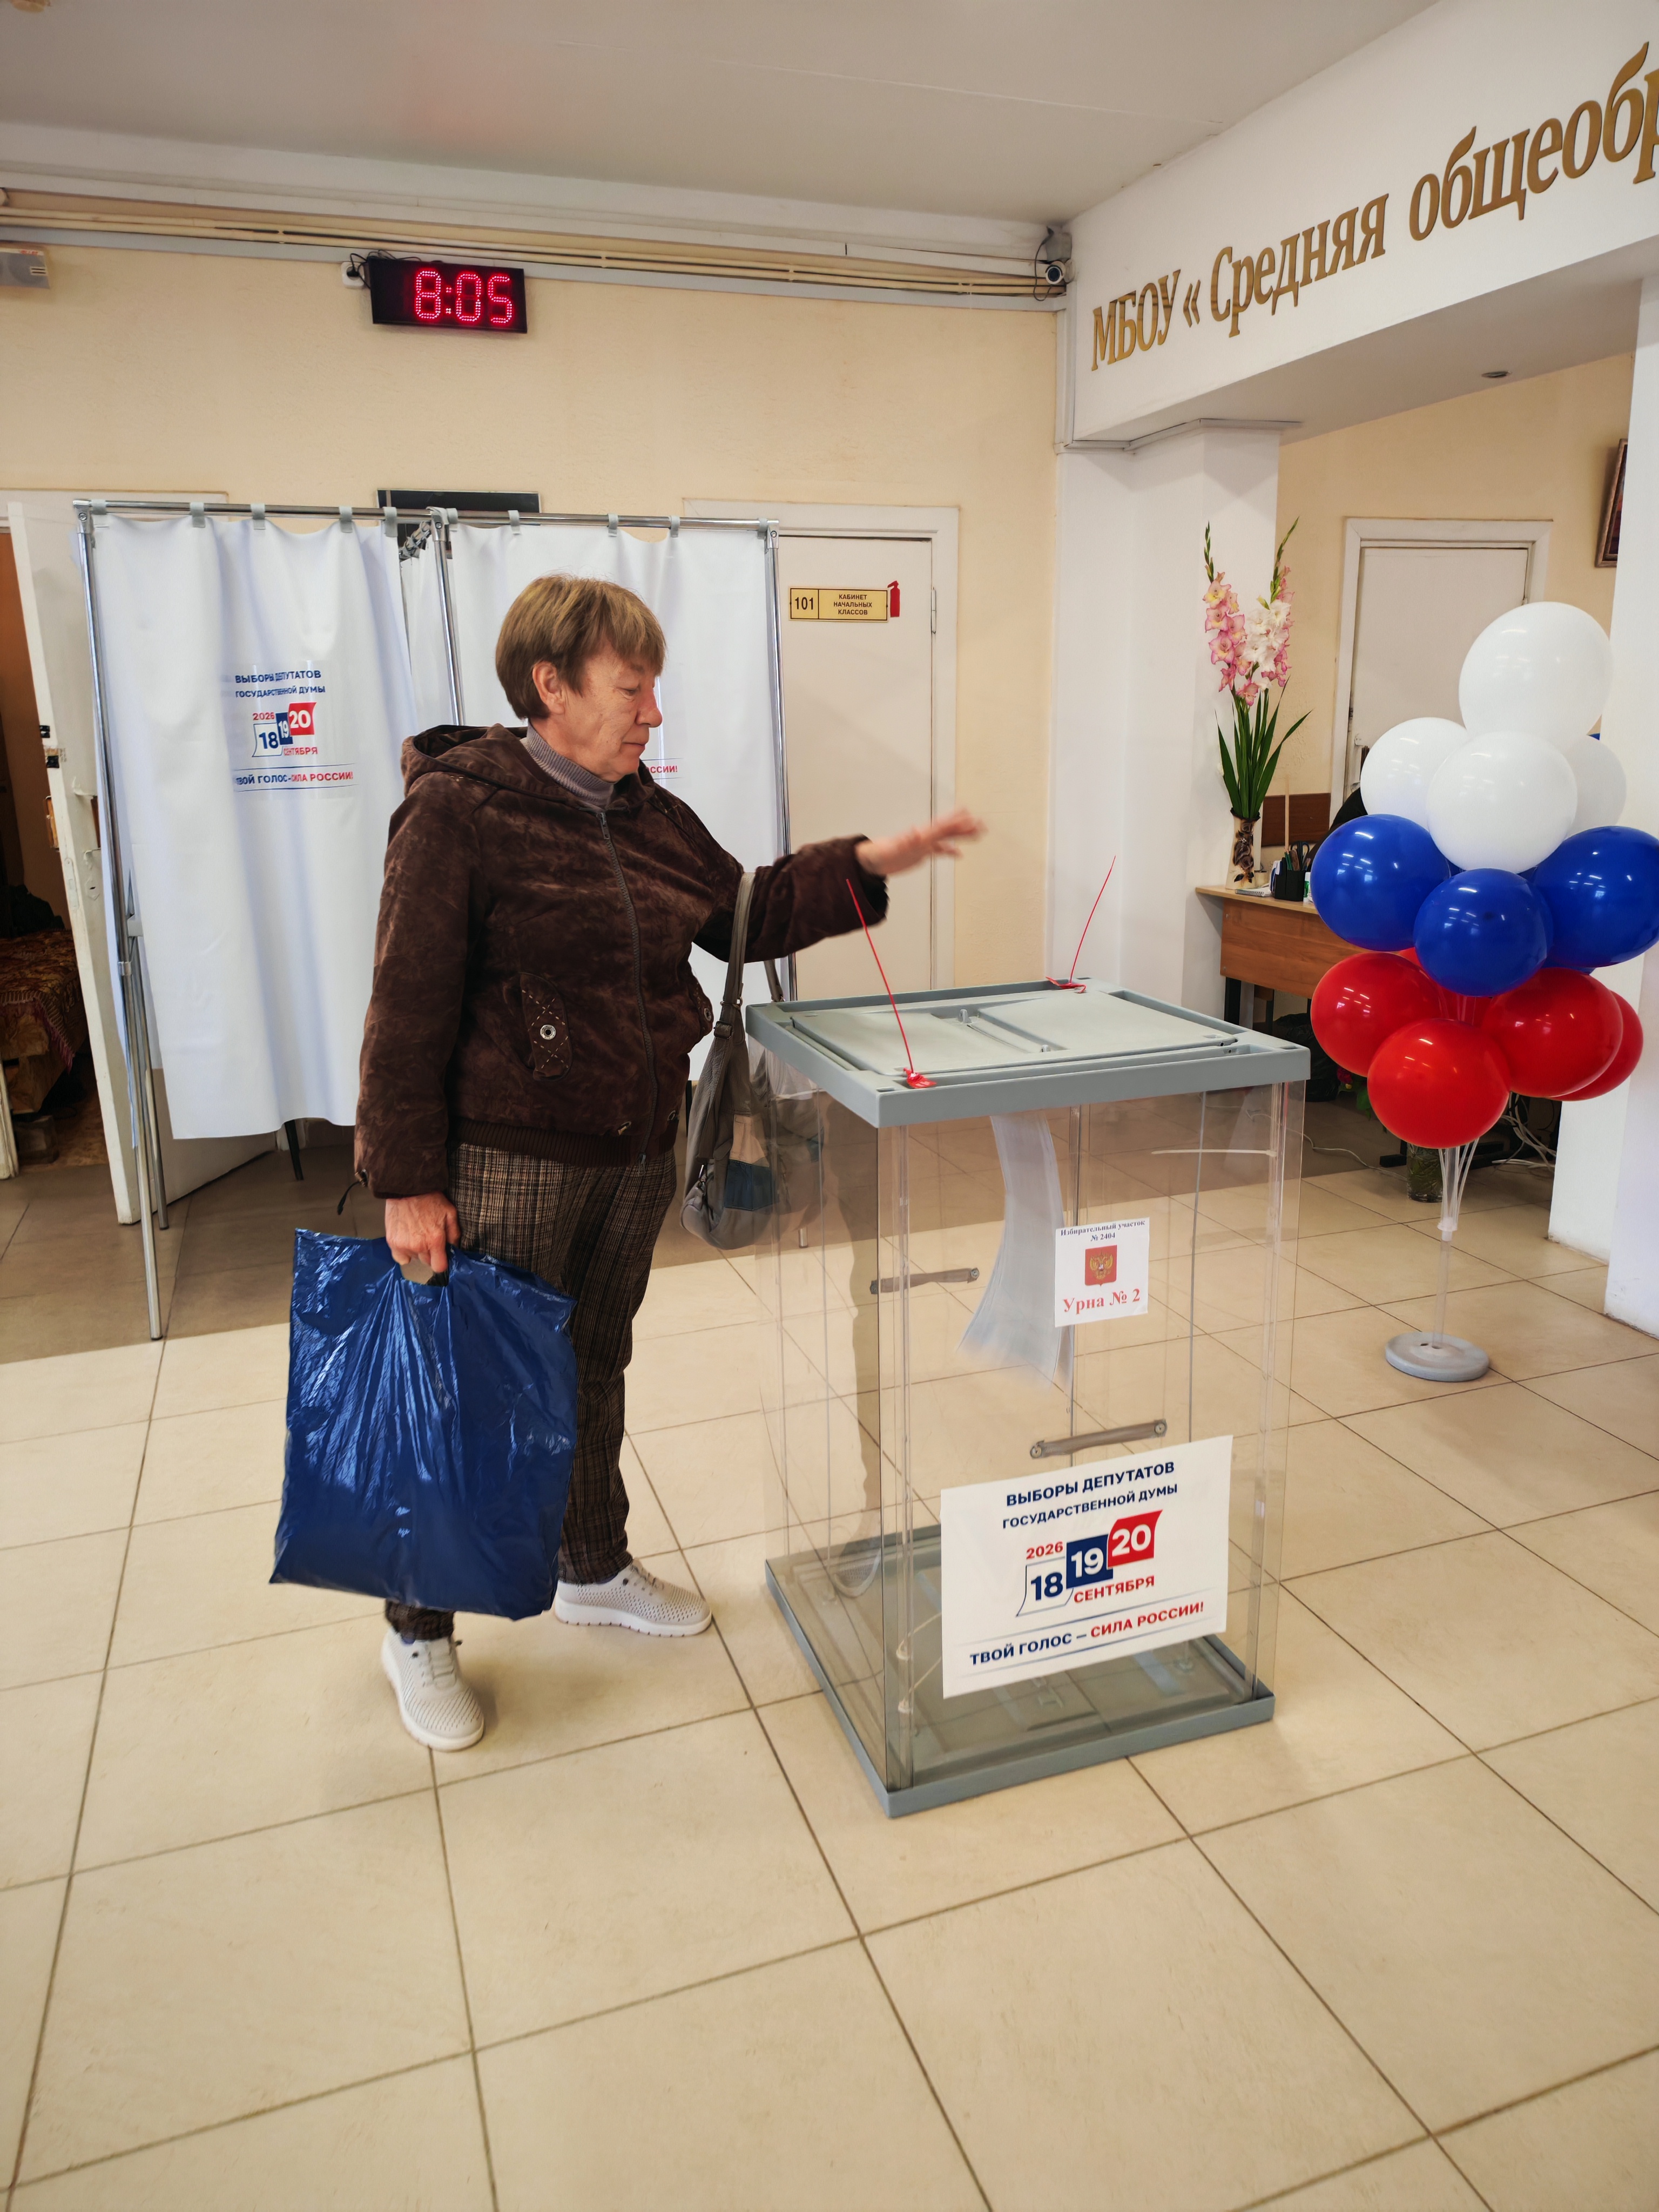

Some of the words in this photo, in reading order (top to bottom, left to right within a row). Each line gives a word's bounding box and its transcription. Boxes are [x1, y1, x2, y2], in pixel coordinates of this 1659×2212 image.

[1091, 269, 1181, 371] МБОУ
[1210, 193, 1389, 338] Средняя
[415, 270, 512, 323] 8:05
[794, 597, 814, 610] 101
[299, 686, 326, 694] ДУМЫ
[253, 712, 275, 720] 2026
[259, 732, 279, 749] 18
[279, 720, 289, 738] 19
[289, 710, 311, 728] 20
[284, 747, 318, 756] ТЯБРЯ
[310, 771, 353, 781] РОССИИ!
[646, 765, 677, 773] ССИИ!
[1061, 1223, 1116, 1236] Избирательный
[1118, 1220, 1145, 1230] участок
[1100, 1232, 1116, 1240] 2404
[1063, 1297, 1104, 1314] Урна
[1109, 1291, 1127, 1306] №
[1132, 1288, 1141, 1303] 2
[1006, 1481, 1077, 1507] ВЫБОРЫ
[1082, 1461, 1175, 1493] ДЕПУТАТОВ
[1003, 1491, 1135, 1529] ГОСУДАРСТВЕННОЙ
[1138, 1484, 1178, 1502] ДУМЫ
[1026, 1541, 1063, 1559] 2026
[1030, 1572, 1063, 1601] 18
[1071, 1547, 1104, 1578] 19
[1111, 1524, 1151, 1557] 20
[1074, 1575, 1155, 1603] СЕНТЯБРЯ
[970, 1643, 1014, 1665] ТВОЙ
[1019, 1633, 1072, 1655] ГОЛОС
[1091, 1618, 1133, 1638] СИЛА
[1137, 1601, 1204, 1627] РОССИИ!
